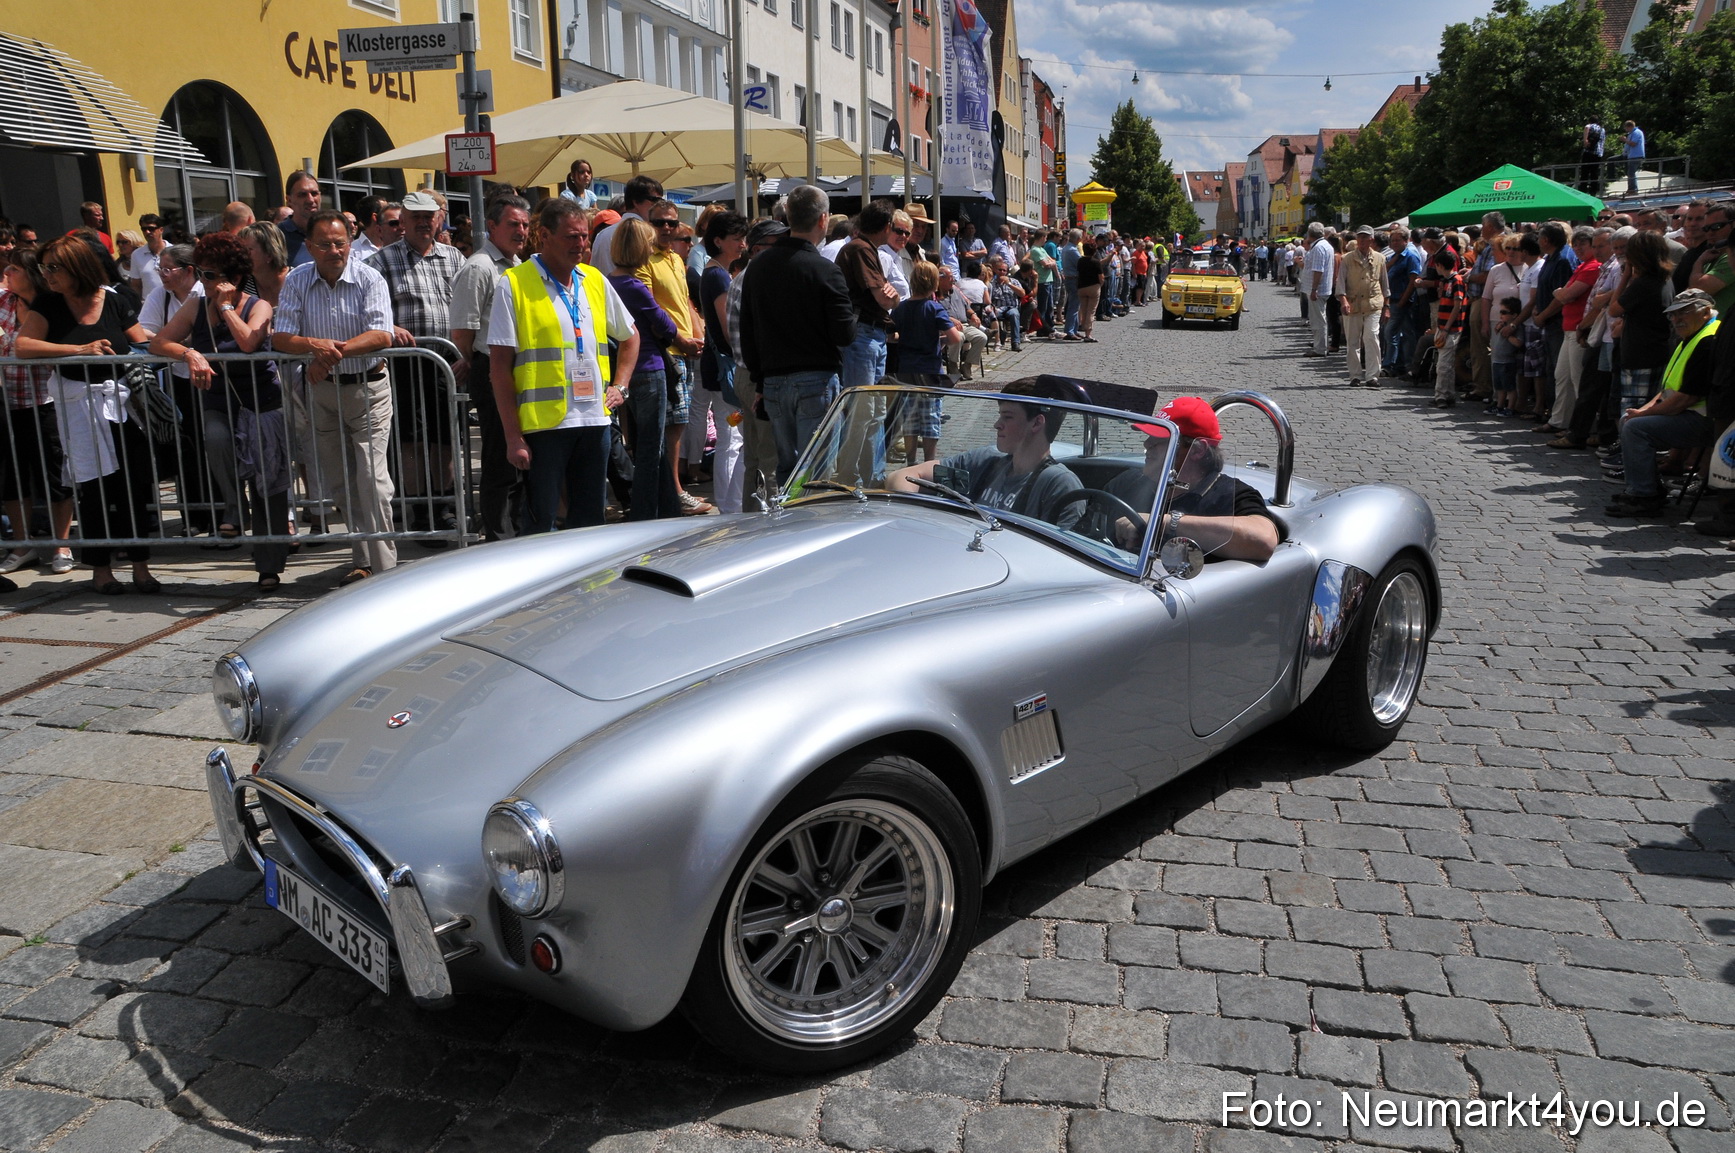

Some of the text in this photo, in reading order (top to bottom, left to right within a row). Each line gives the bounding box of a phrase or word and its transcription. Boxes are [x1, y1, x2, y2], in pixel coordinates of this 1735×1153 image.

[346, 33, 446, 55] Klostergasse
[451, 137, 482, 148] H 200
[1055, 153, 1066, 207] HOTEL
[1462, 194, 1536, 204] Lammsbräu
[1018, 701, 1034, 713] 427
[312, 895, 333, 944] AC
[337, 913, 373, 974] 333
